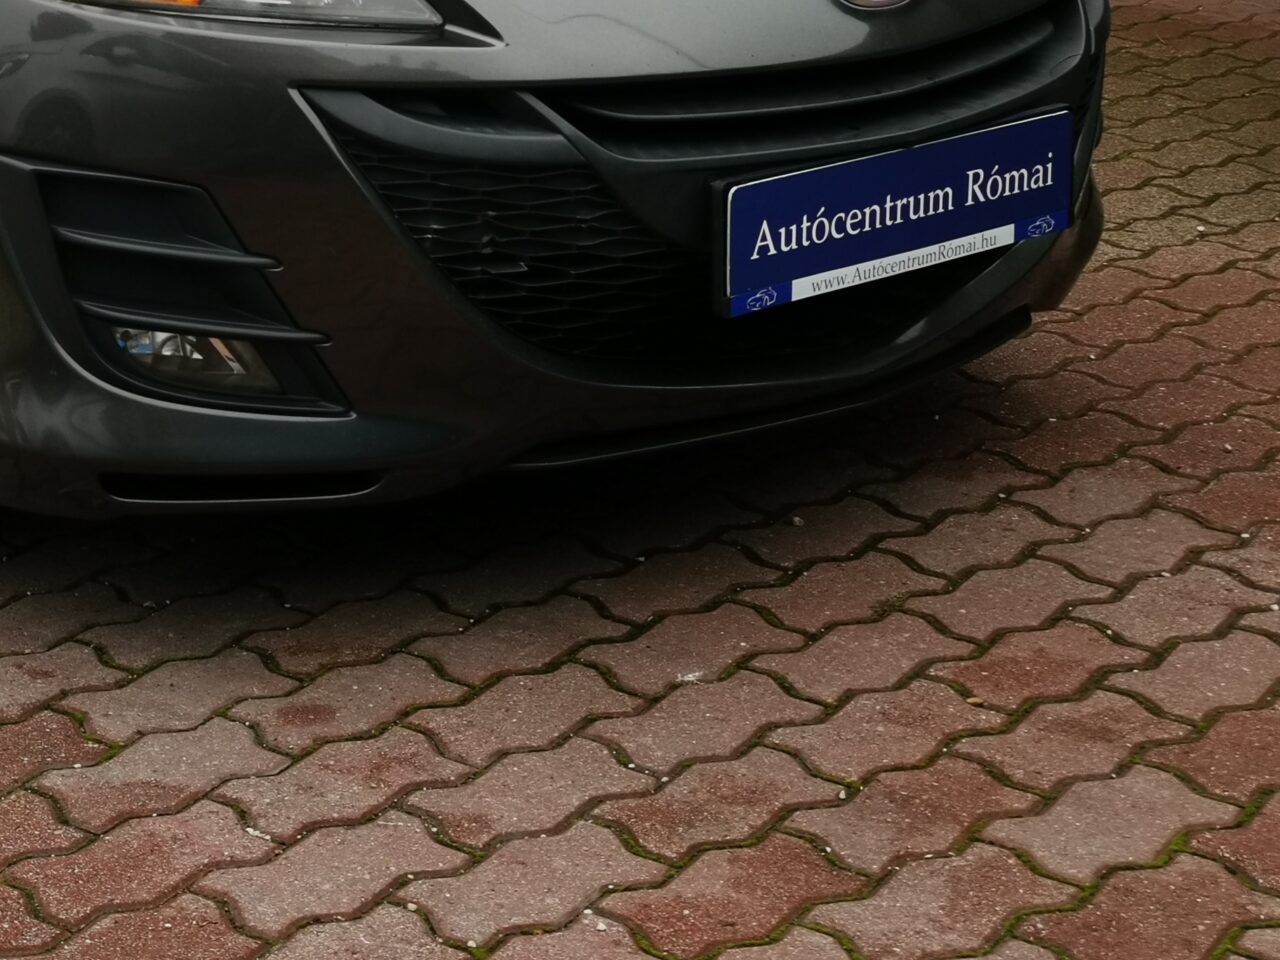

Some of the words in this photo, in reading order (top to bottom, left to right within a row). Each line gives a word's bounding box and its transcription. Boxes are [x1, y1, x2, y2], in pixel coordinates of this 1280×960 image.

[750, 186, 954, 260] Autócentrum
[965, 152, 1054, 206] Római
[811, 233, 997, 293] www.AutócentrumRómai.hu
